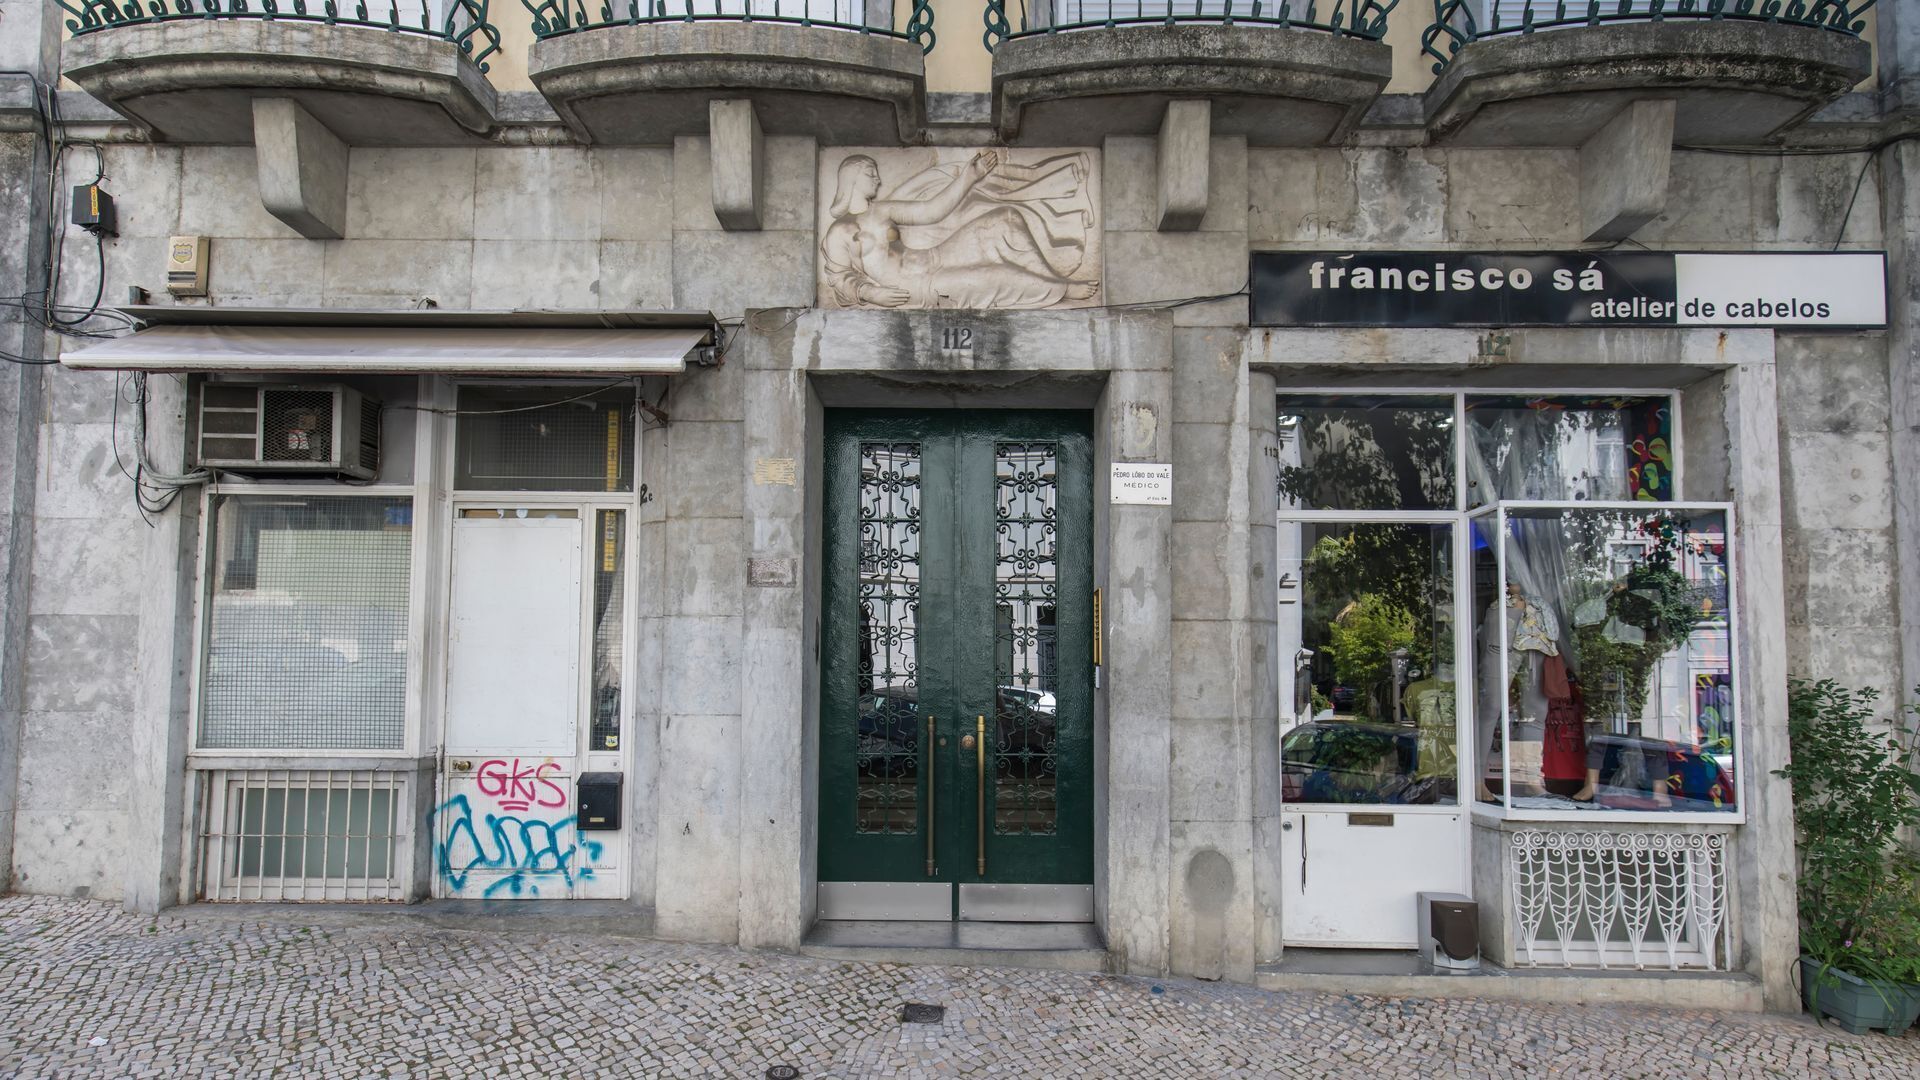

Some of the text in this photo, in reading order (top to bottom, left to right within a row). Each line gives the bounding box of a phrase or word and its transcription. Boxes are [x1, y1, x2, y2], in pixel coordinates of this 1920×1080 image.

[1309, 261, 1604, 292] francisco sá
[1590, 297, 1831, 318] atelier de cabelos
[942, 327, 972, 350] 112
